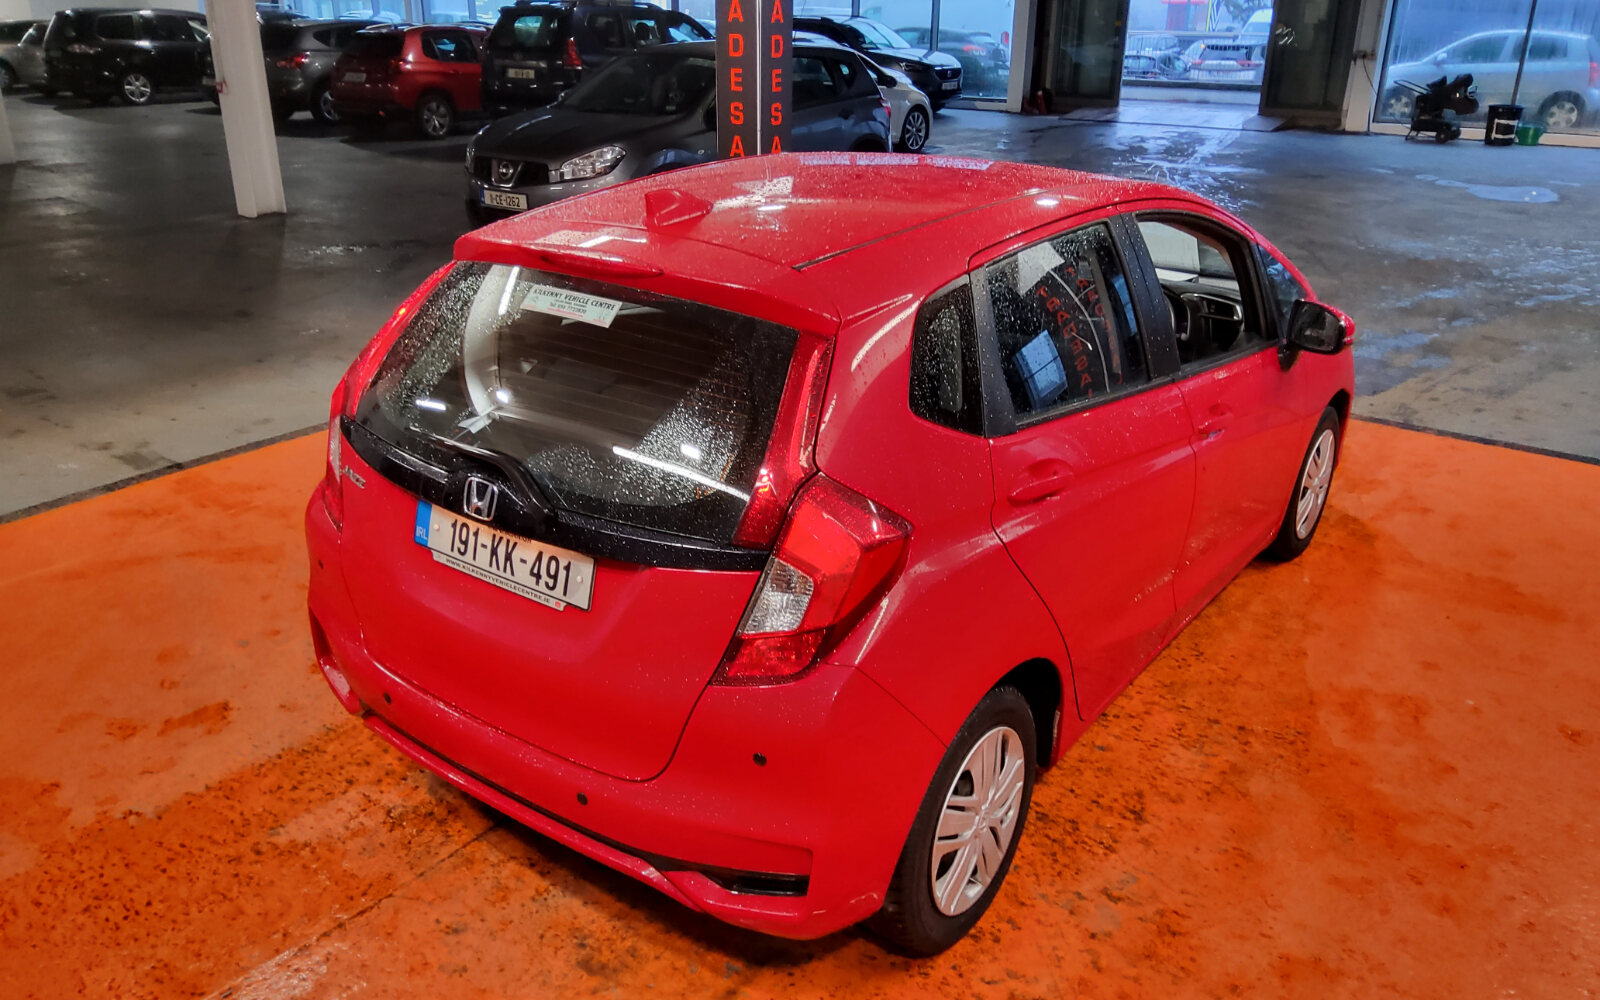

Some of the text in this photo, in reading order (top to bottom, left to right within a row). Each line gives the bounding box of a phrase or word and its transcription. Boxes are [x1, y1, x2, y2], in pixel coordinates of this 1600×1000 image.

[564, 294, 590, 305] VEHICLE
[590, 300, 617, 311] CENTRE
[415, 525, 428, 541] IRL
[450, 518, 573, 597] 191-KK-491
